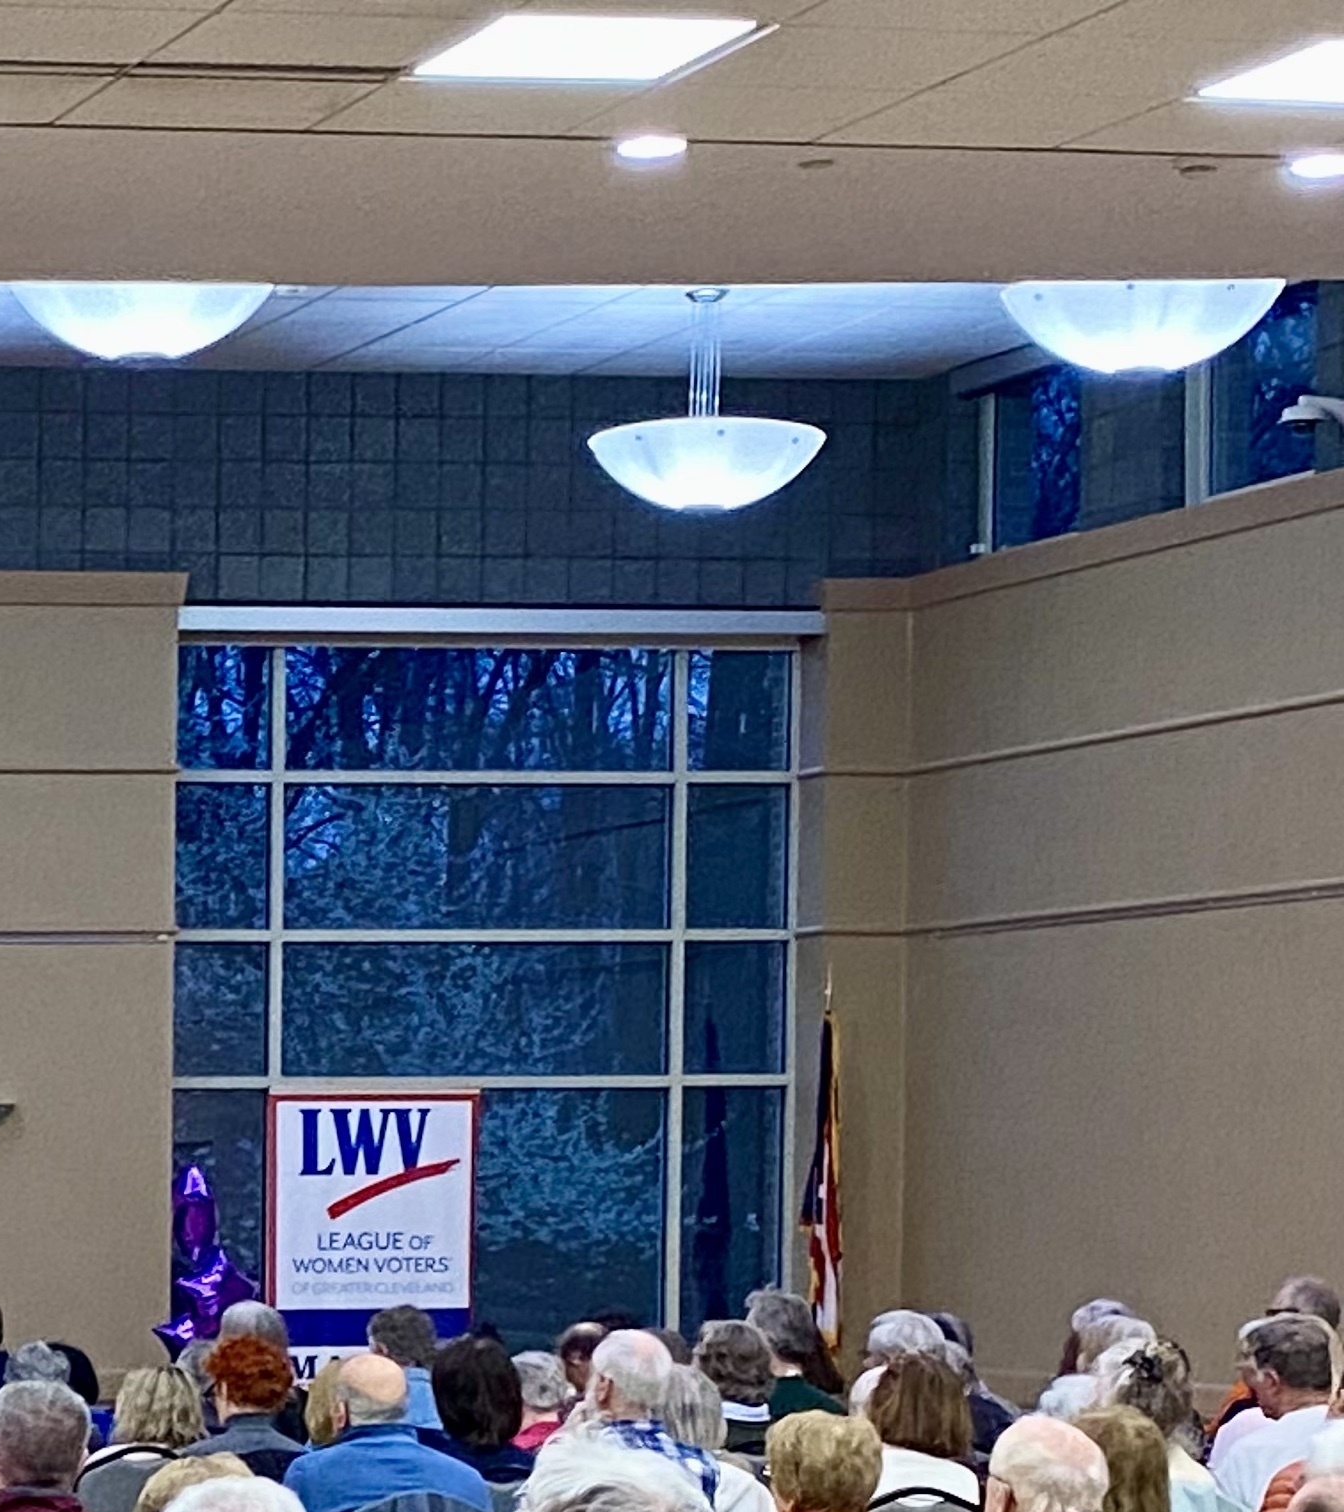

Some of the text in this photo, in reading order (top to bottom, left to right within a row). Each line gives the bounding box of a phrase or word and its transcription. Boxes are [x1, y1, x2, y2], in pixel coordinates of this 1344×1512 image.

[298, 1108, 432, 1176] LWV
[317, 1231, 404, 1251] LEAGUE
[292, 1256, 450, 1274] WOMEN VOTERS
